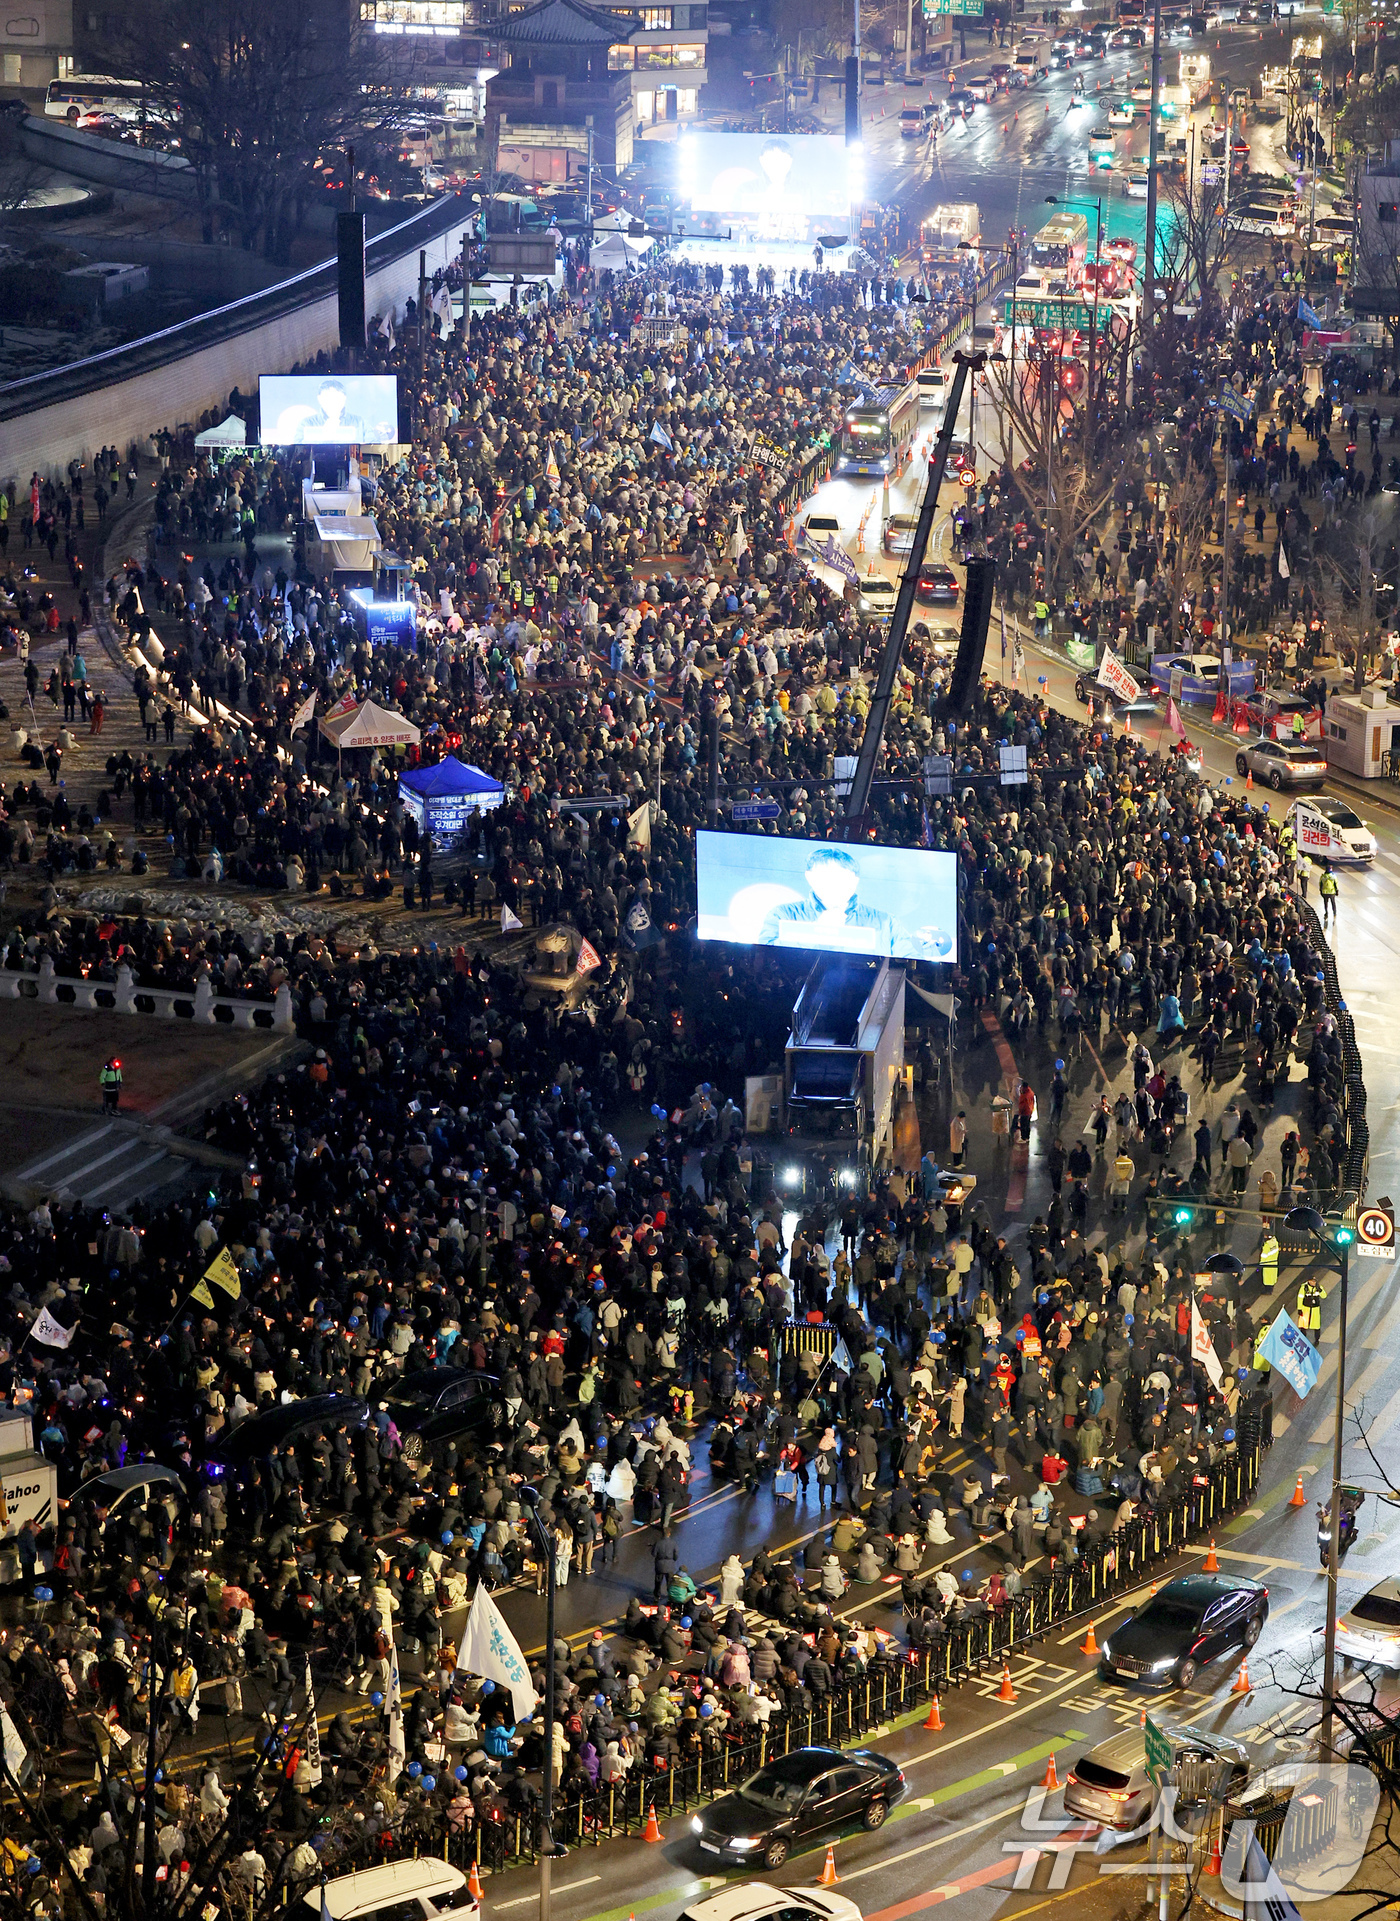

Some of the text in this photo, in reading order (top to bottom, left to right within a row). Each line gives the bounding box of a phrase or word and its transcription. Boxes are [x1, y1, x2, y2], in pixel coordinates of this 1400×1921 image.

[350, 737, 373, 745] 손피켓
[396, 734, 411, 742] 배포
[1302, 829, 1330, 847] 김건희
[1365, 1218, 1385, 1237] 40
[1360, 1246, 1392, 1256] 도심부
[1279, 1350, 1309, 1389] 촛불행동
[4, 1484, 41, 1501] iahoo
